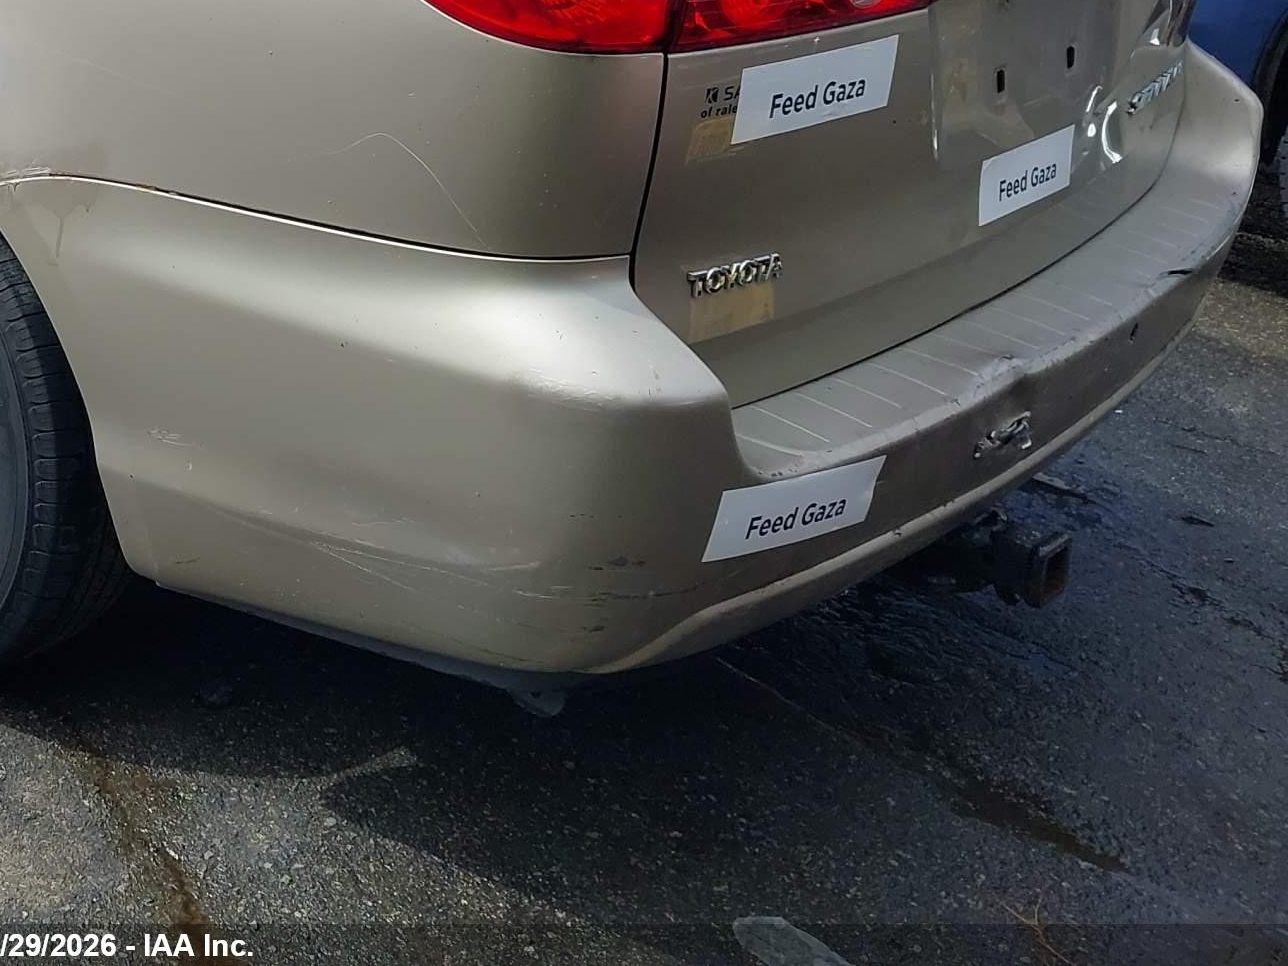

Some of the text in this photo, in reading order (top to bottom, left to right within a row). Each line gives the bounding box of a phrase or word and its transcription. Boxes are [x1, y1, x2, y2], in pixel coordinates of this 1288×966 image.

[769, 78, 866, 120] Feed Gaza
[998, 162, 1057, 203] Feed Gaza
[687, 251, 783, 299] TOYOTA
[745, 498, 847, 540] Feed Gaza
